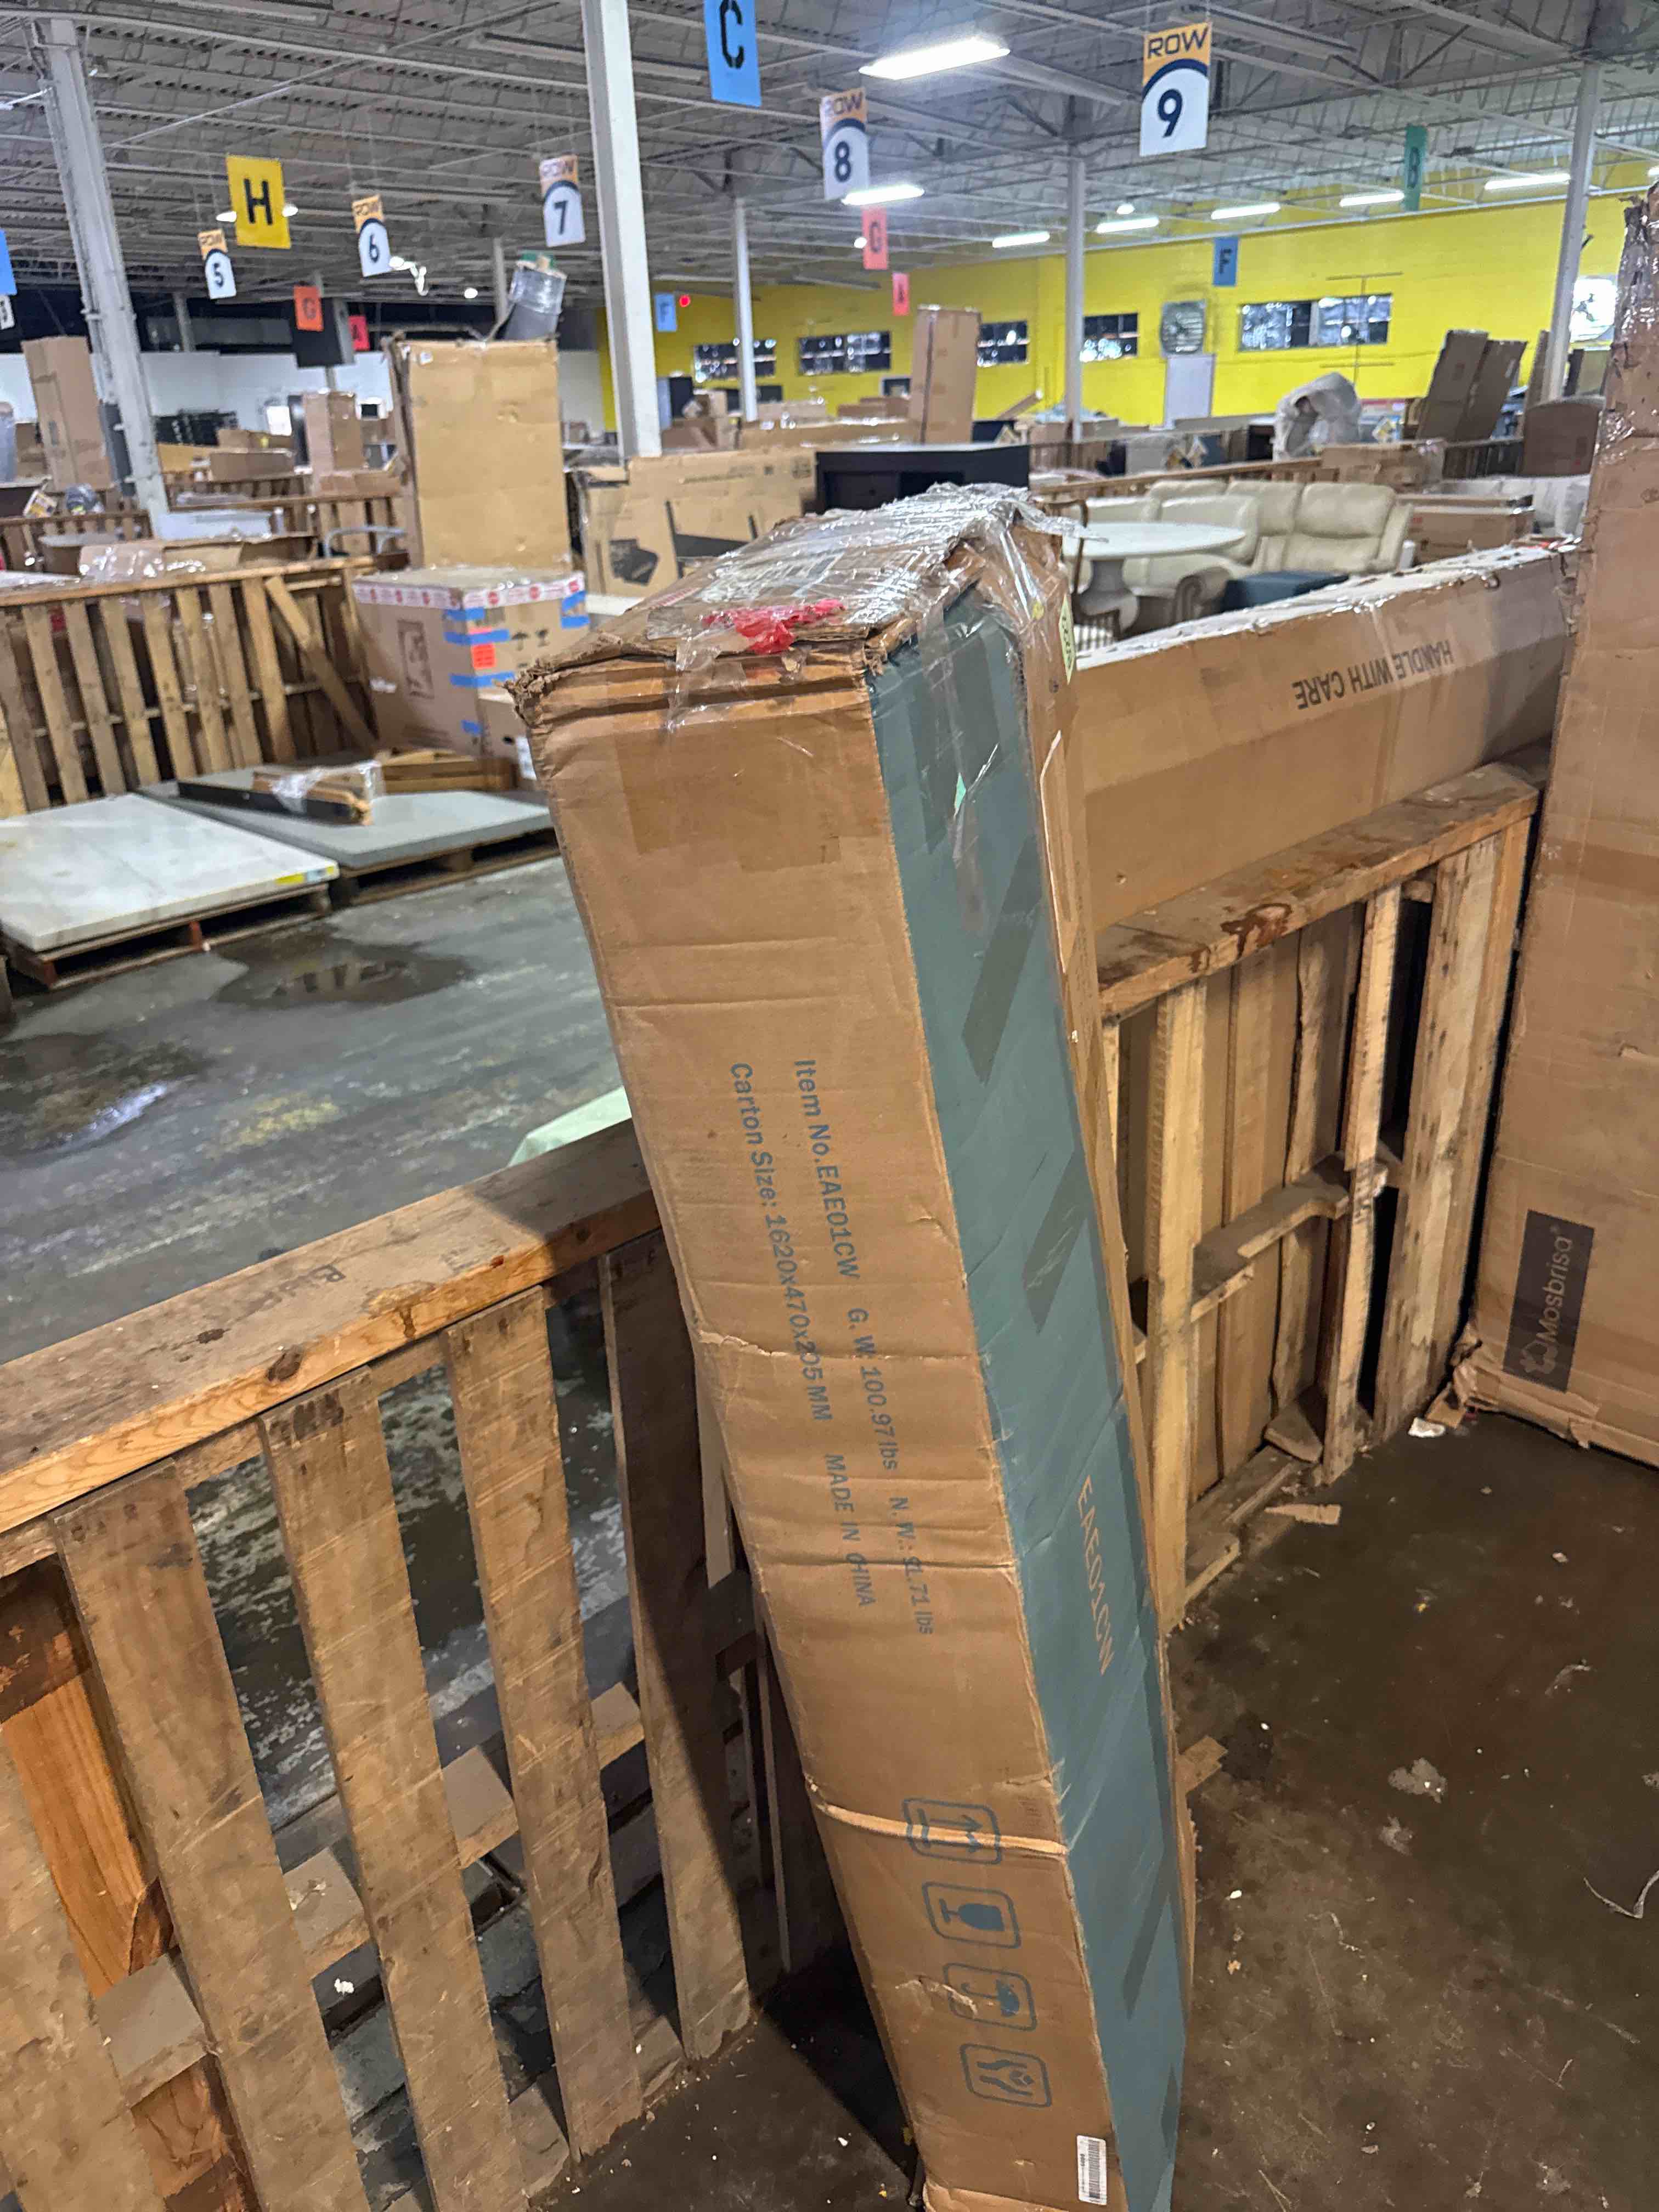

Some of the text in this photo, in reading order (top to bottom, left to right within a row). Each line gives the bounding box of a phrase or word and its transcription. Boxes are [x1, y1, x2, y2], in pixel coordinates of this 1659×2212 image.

[719, 0, 744, 69] C
[1147, 27, 1208, 59] ROW
[1157, 88, 1183, 138] 9
[834, 140, 851, 183] 8
[244, 178, 273, 225] H
[554, 200, 568, 235] 7
[368, 233, 380, 263] 6
[212, 262, 224, 288] 5
[1291, 640, 1455, 710] HANDLE WITH CARE
[794, 1059, 822, 1117] Item
[730, 1062, 764, 1145] Carton
[750, 1150, 777, 1207] Size:
[825, 1453, 877, 1607] MADE IN CHINA
[1077, 1474, 1114, 1676] EAE01CW
